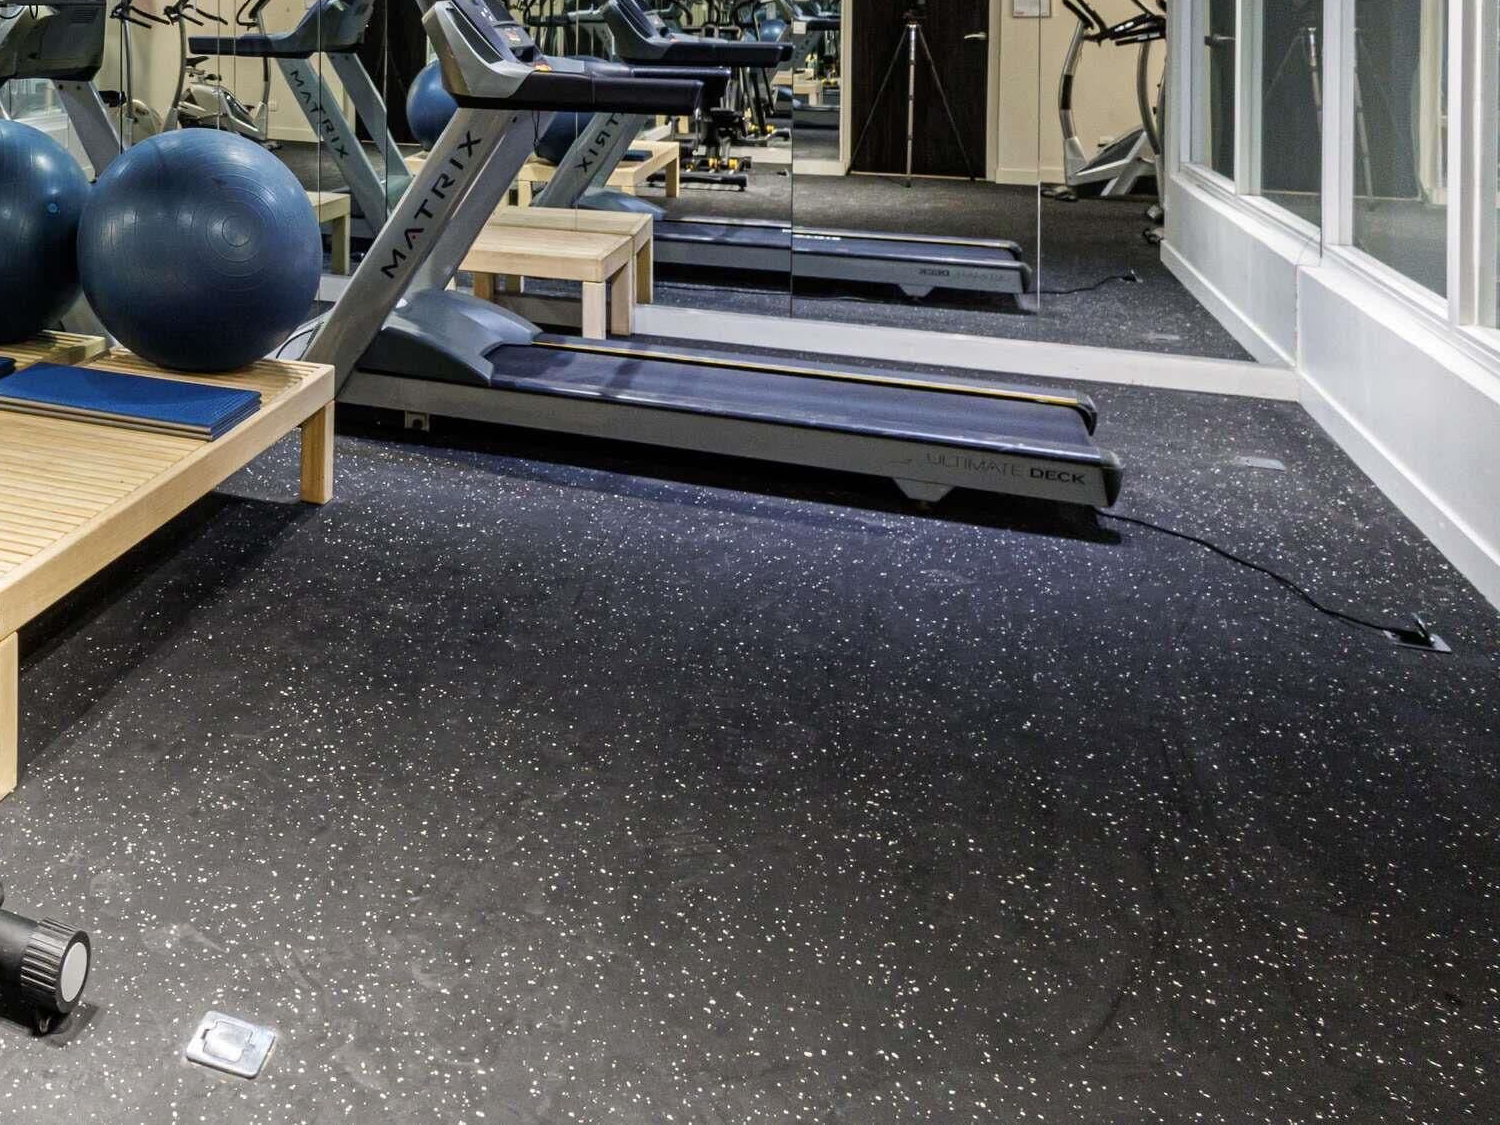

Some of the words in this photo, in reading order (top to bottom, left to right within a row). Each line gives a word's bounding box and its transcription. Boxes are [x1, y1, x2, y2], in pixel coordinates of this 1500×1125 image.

[289, 70, 349, 159] MATRIX
[380, 130, 482, 279] MATRIX
[926, 452, 1022, 476] ULTIMATE
[1029, 467, 1086, 485] DECK
